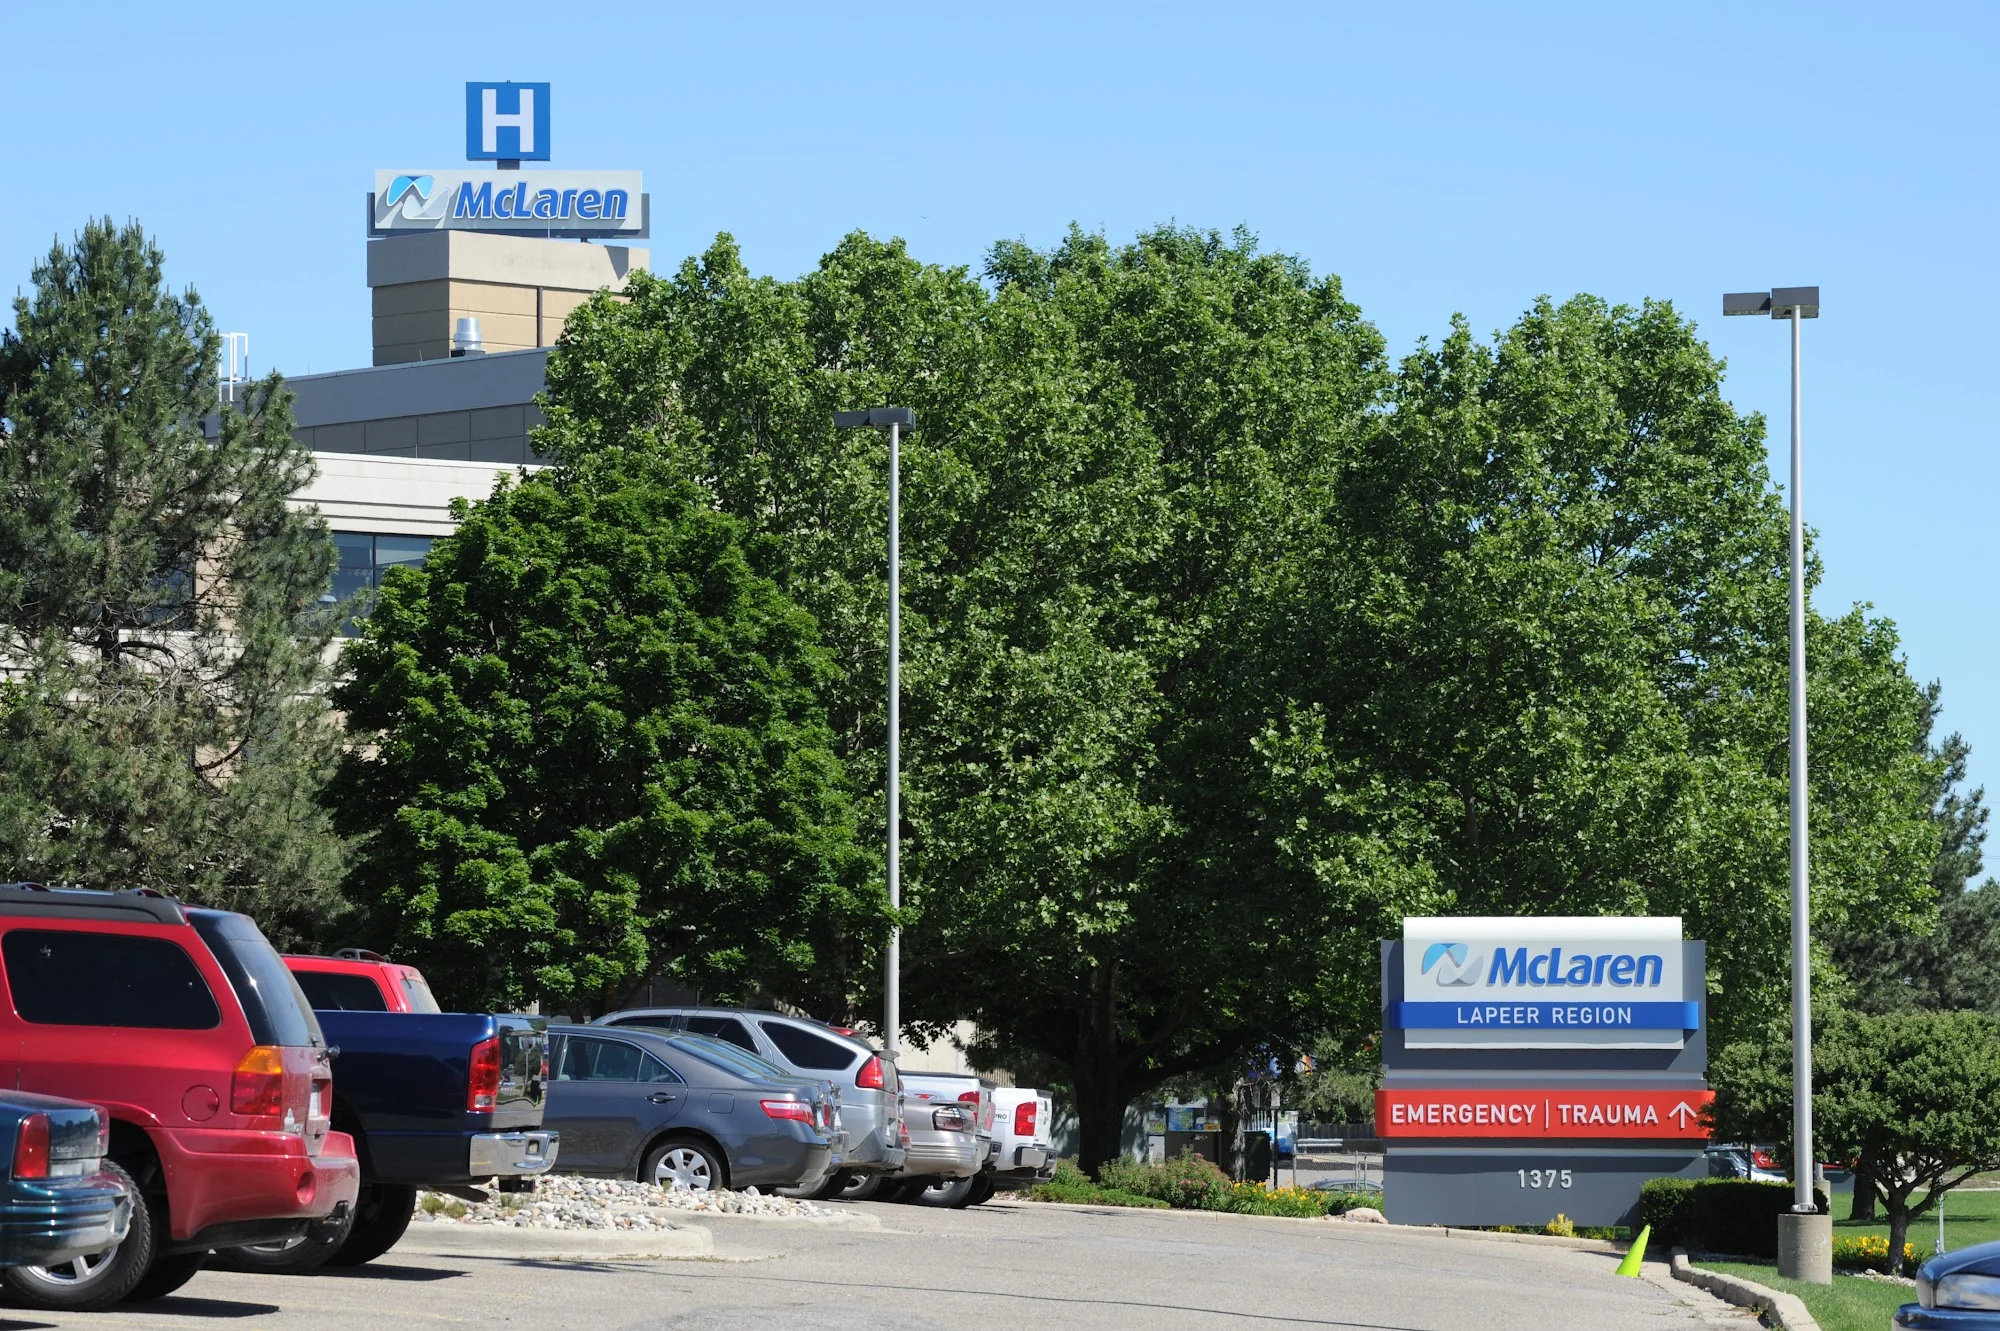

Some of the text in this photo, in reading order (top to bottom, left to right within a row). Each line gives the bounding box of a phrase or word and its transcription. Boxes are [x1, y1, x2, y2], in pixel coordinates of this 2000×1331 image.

[482, 88, 534, 153] H
[453, 180, 628, 220] McLaren
[1487, 947, 1664, 986] McLaren
[1457, 1006, 1632, 1024] LAPEER REGION
[1391, 1104, 1660, 1124] EMERGENCY TRAUMA
[1517, 1169, 1572, 1189] 1375
